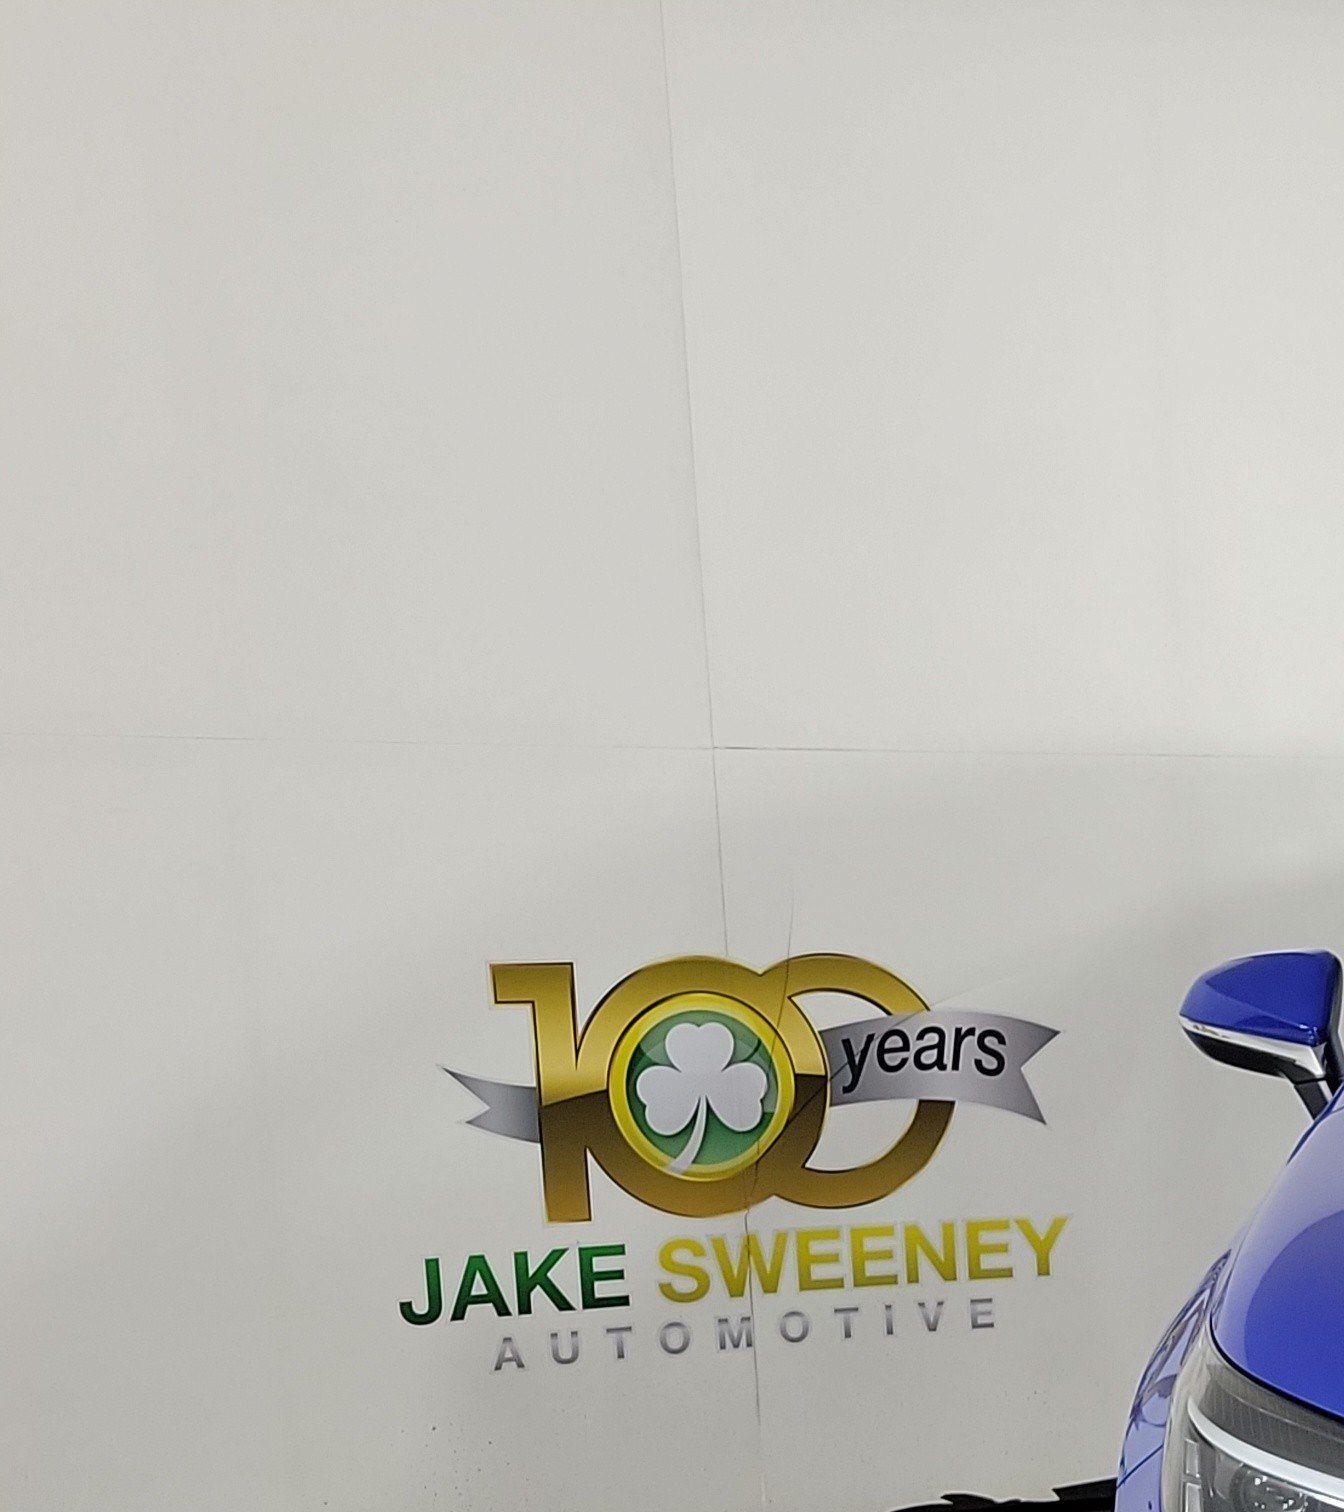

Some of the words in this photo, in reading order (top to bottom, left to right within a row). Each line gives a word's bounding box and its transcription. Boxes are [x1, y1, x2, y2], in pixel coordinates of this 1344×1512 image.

[488, 953, 957, 1224] 100
[841, 1025, 1008, 1093] years
[399, 1243, 631, 1327] JAKE
[657, 1216, 1069, 1304] SWEENEY
[493, 1298, 996, 1372] AUTOMOTIVE
